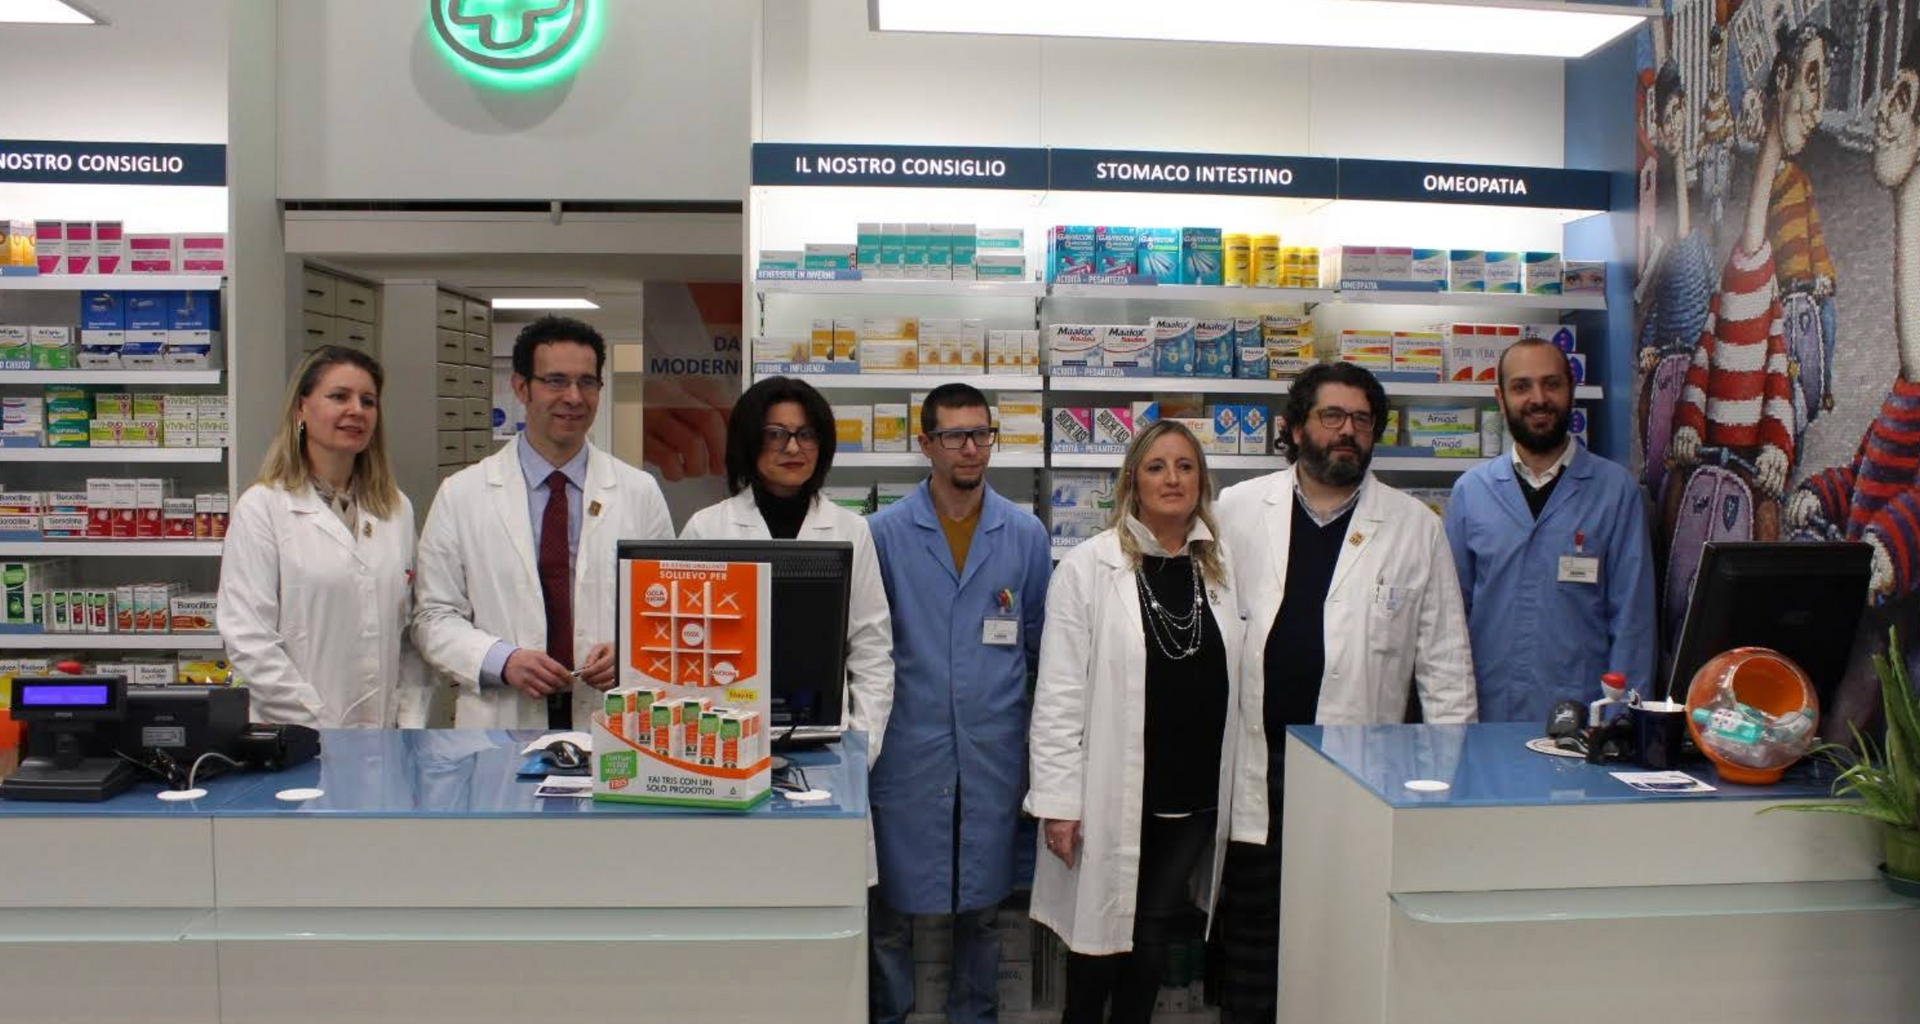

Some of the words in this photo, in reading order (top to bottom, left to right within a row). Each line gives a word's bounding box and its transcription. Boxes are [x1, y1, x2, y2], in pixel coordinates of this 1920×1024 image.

[78, 155, 183, 173] CONSIGLIO
[796, 157, 811, 173] IL
[818, 157, 896, 174] NOSTRO
[902, 158, 1006, 177] CONSIGLIO
[1097, 163, 1190, 182] STOMACO
[1196, 166, 1293, 185] INTESTINO
[1424, 174, 1526, 194] OMEOPATIA
[758, 270, 796, 279] BENESSERE
[797, 270, 805, 279] IN
[806, 270, 834, 279] INVERNO
[1088, 275, 1128, 284] PESANTEZZA
[1342, 281, 1378, 290] OMEOPATIA
[1156, 320, 1190, 330] Maalox
[1196, 322, 1229, 331] Maalox
[1057, 327, 1094, 336] Maalox
[1108, 327, 1145, 337] Maalox
[714, 336, 740, 352] DA
[1069, 335, 1096, 343] Nausea
[5, 360, 30, 370] CHIUSO
[789, 364, 826, 373] INFLUENZA
[1084, 368, 1124, 377] PESANTEZZA
[1085, 445, 1125, 454] PESANTEZZA
[659, 570, 706, 580] SOLLIEVO
[709, 572, 727, 581] PER
[648, 775, 660, 784] FAI
[662, 776, 677, 784] TRIS
[679, 777, 697, 786] CON
[699, 779, 712, 787] UN
[646, 784, 667, 793] SOLO
[669, 786, 715, 795] PRODOTTO!
